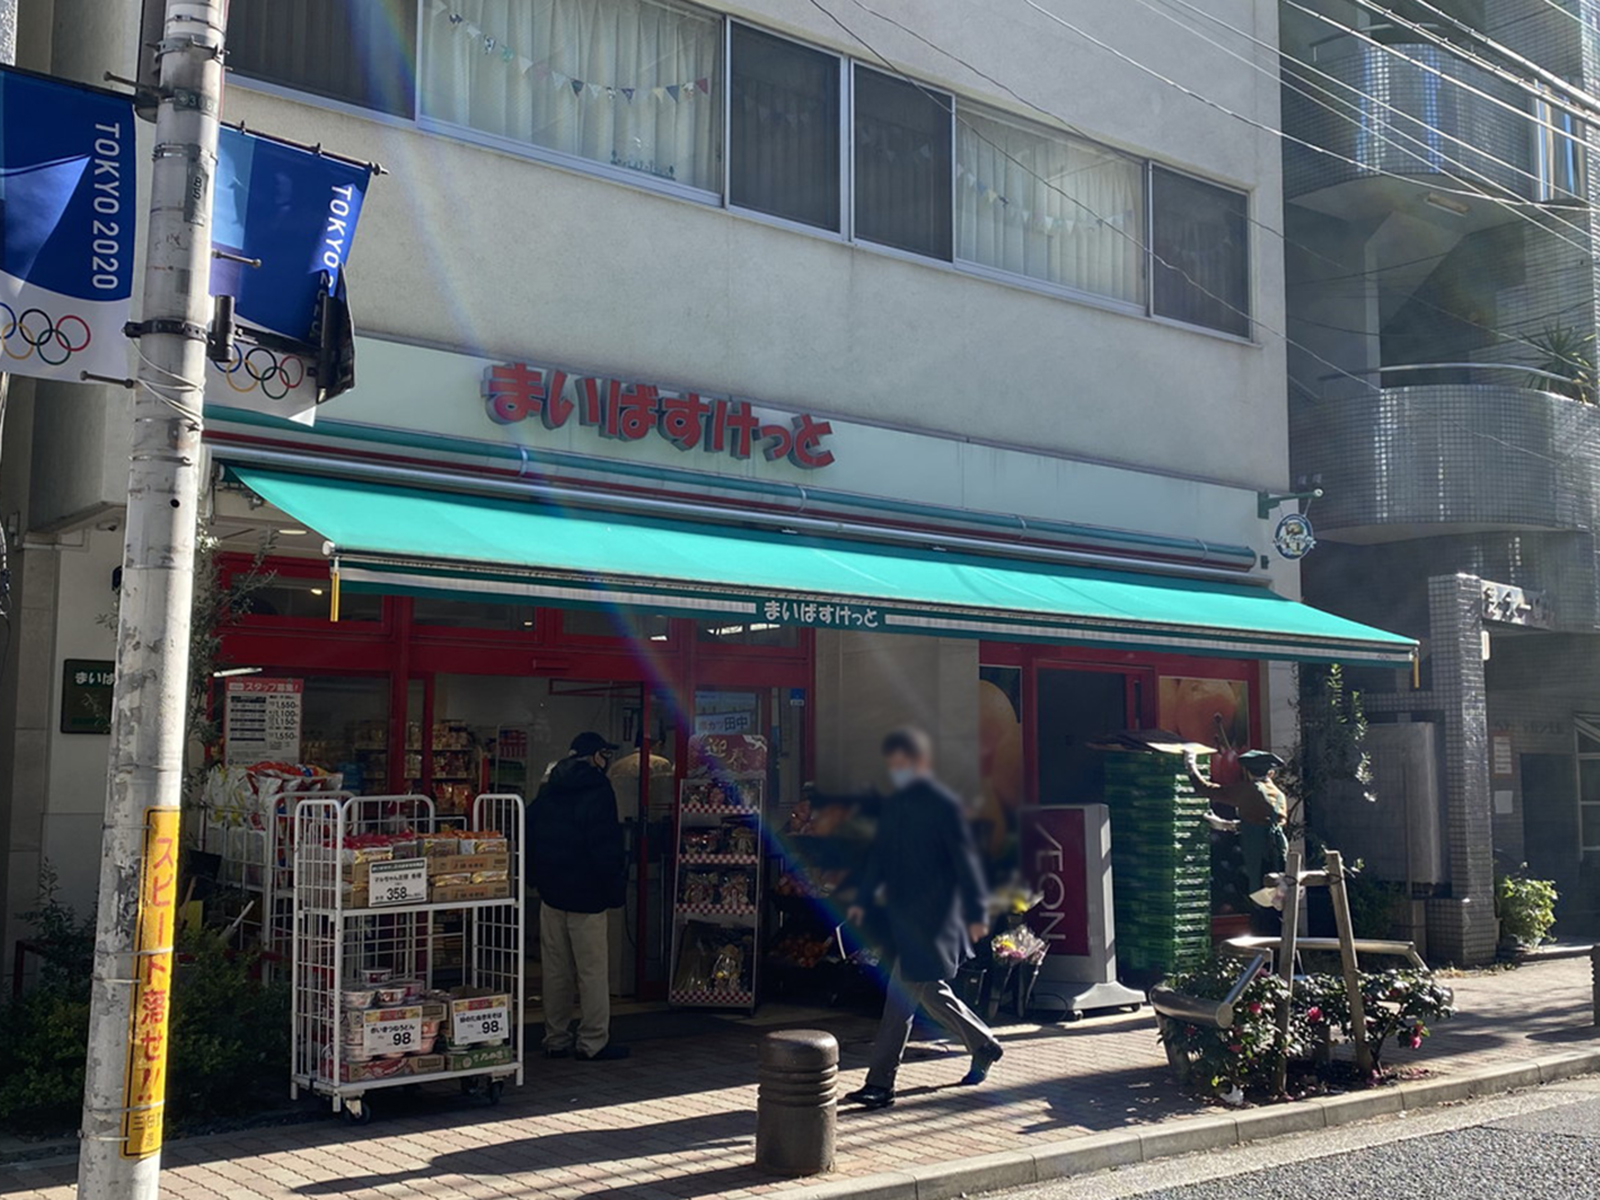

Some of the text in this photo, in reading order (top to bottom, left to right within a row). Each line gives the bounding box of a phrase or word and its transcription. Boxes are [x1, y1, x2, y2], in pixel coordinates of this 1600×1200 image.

[92, 123, 120, 289] TOKYO 2020
[323, 186, 353, 269] TOKYO
[481, 362, 836, 470] まいばすけっと
[764, 600, 878, 627] まいばすけっと
[386, 886, 408, 900] 358
[1034, 822, 1066, 940] AEON
[393, 1032, 411, 1046] 98
[482, 1020, 499, 1034] 98
